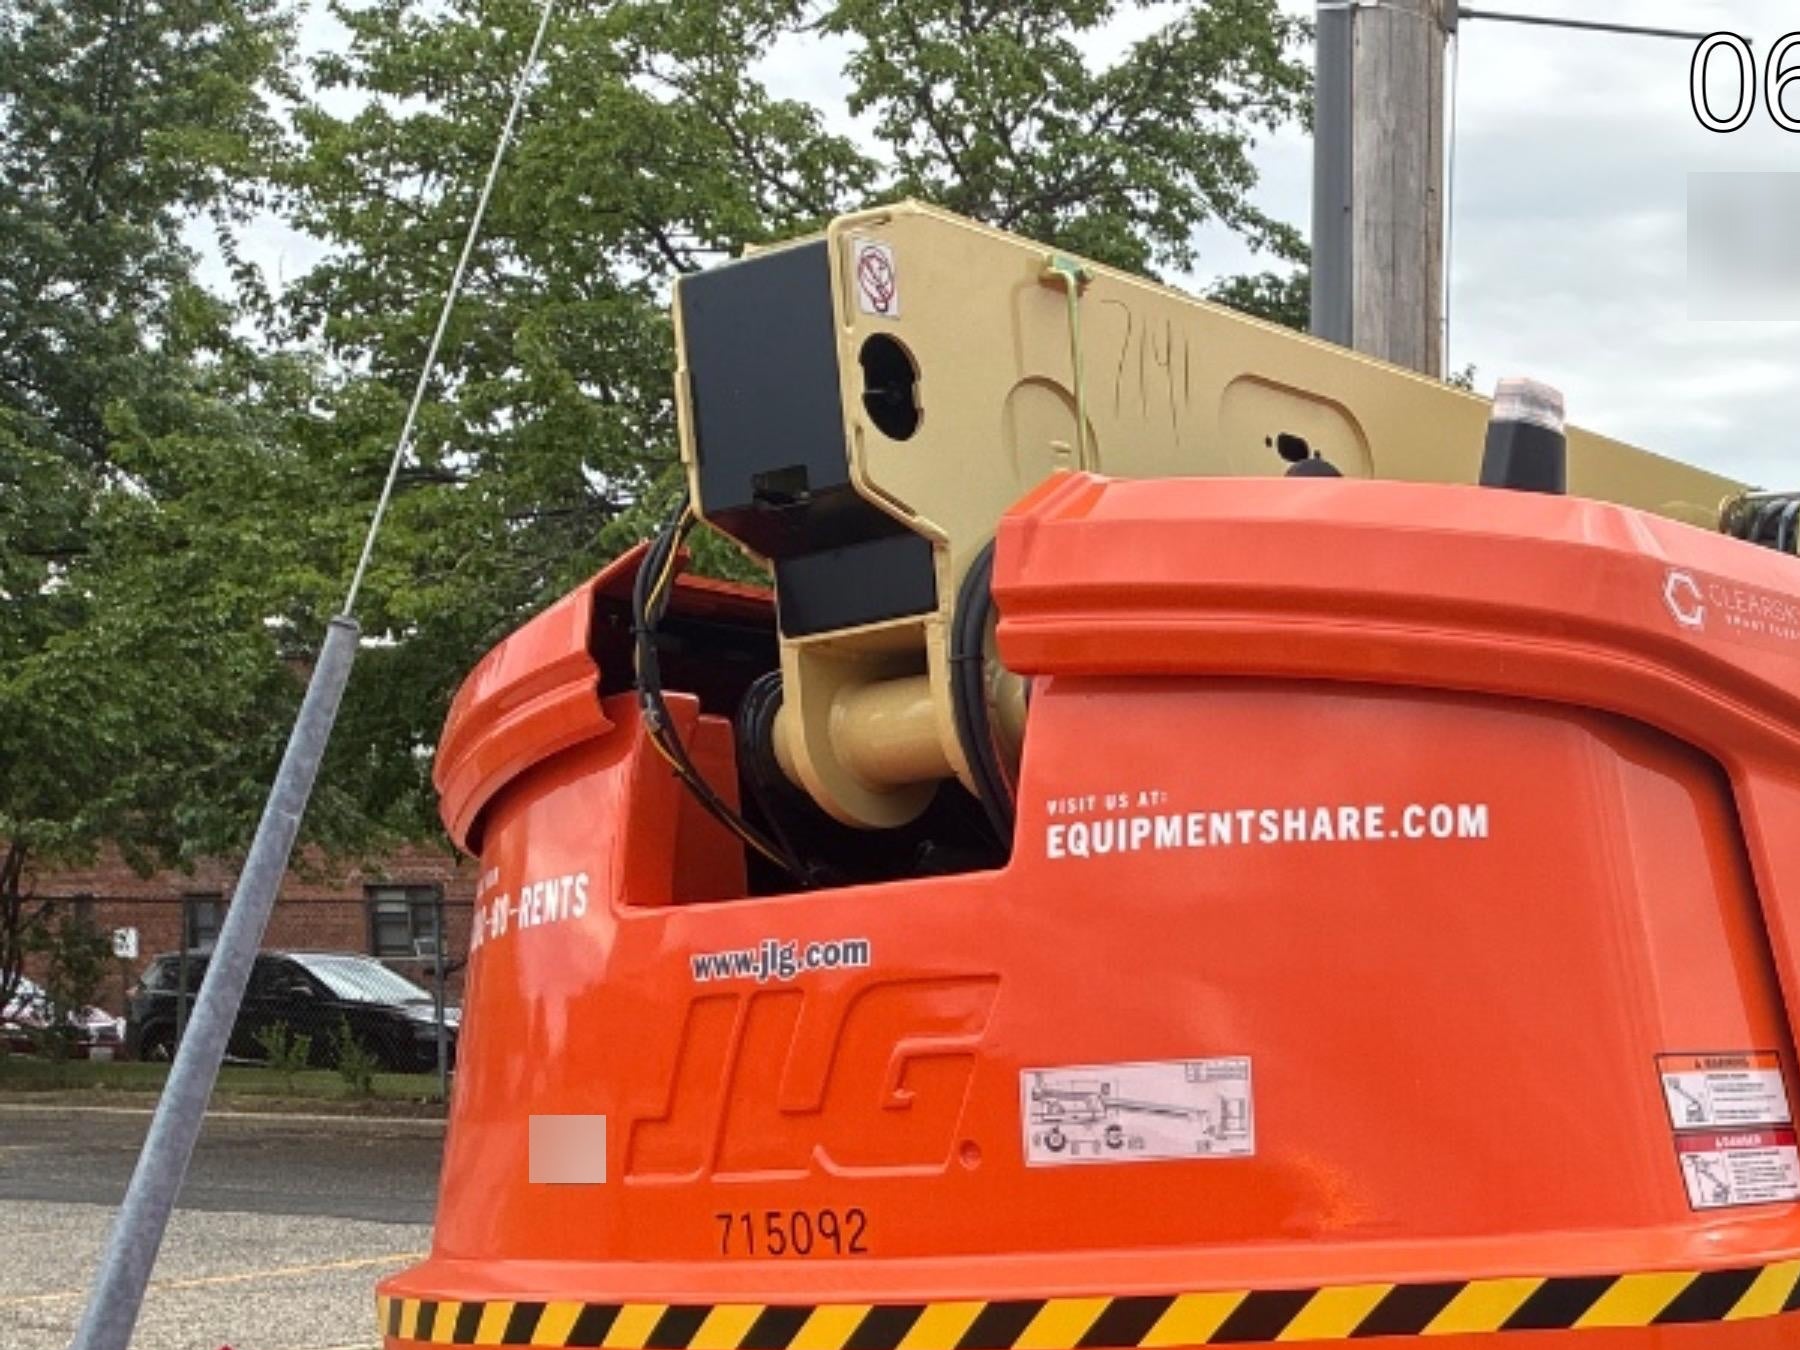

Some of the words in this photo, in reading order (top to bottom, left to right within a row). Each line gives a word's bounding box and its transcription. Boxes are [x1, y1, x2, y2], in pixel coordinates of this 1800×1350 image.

[1046, 794, 1096, 817] VISIT
[1105, 793, 1129, 812] US
[1136, 790, 1169, 809] AT:
[1046, 803, 1490, 859] EQUIPMENTSHARE.COM
[691, 938, 870, 981] www.jlg.com
[624, 972, 1002, 1185] JLG
[715, 1208, 869, 1256] 715092
